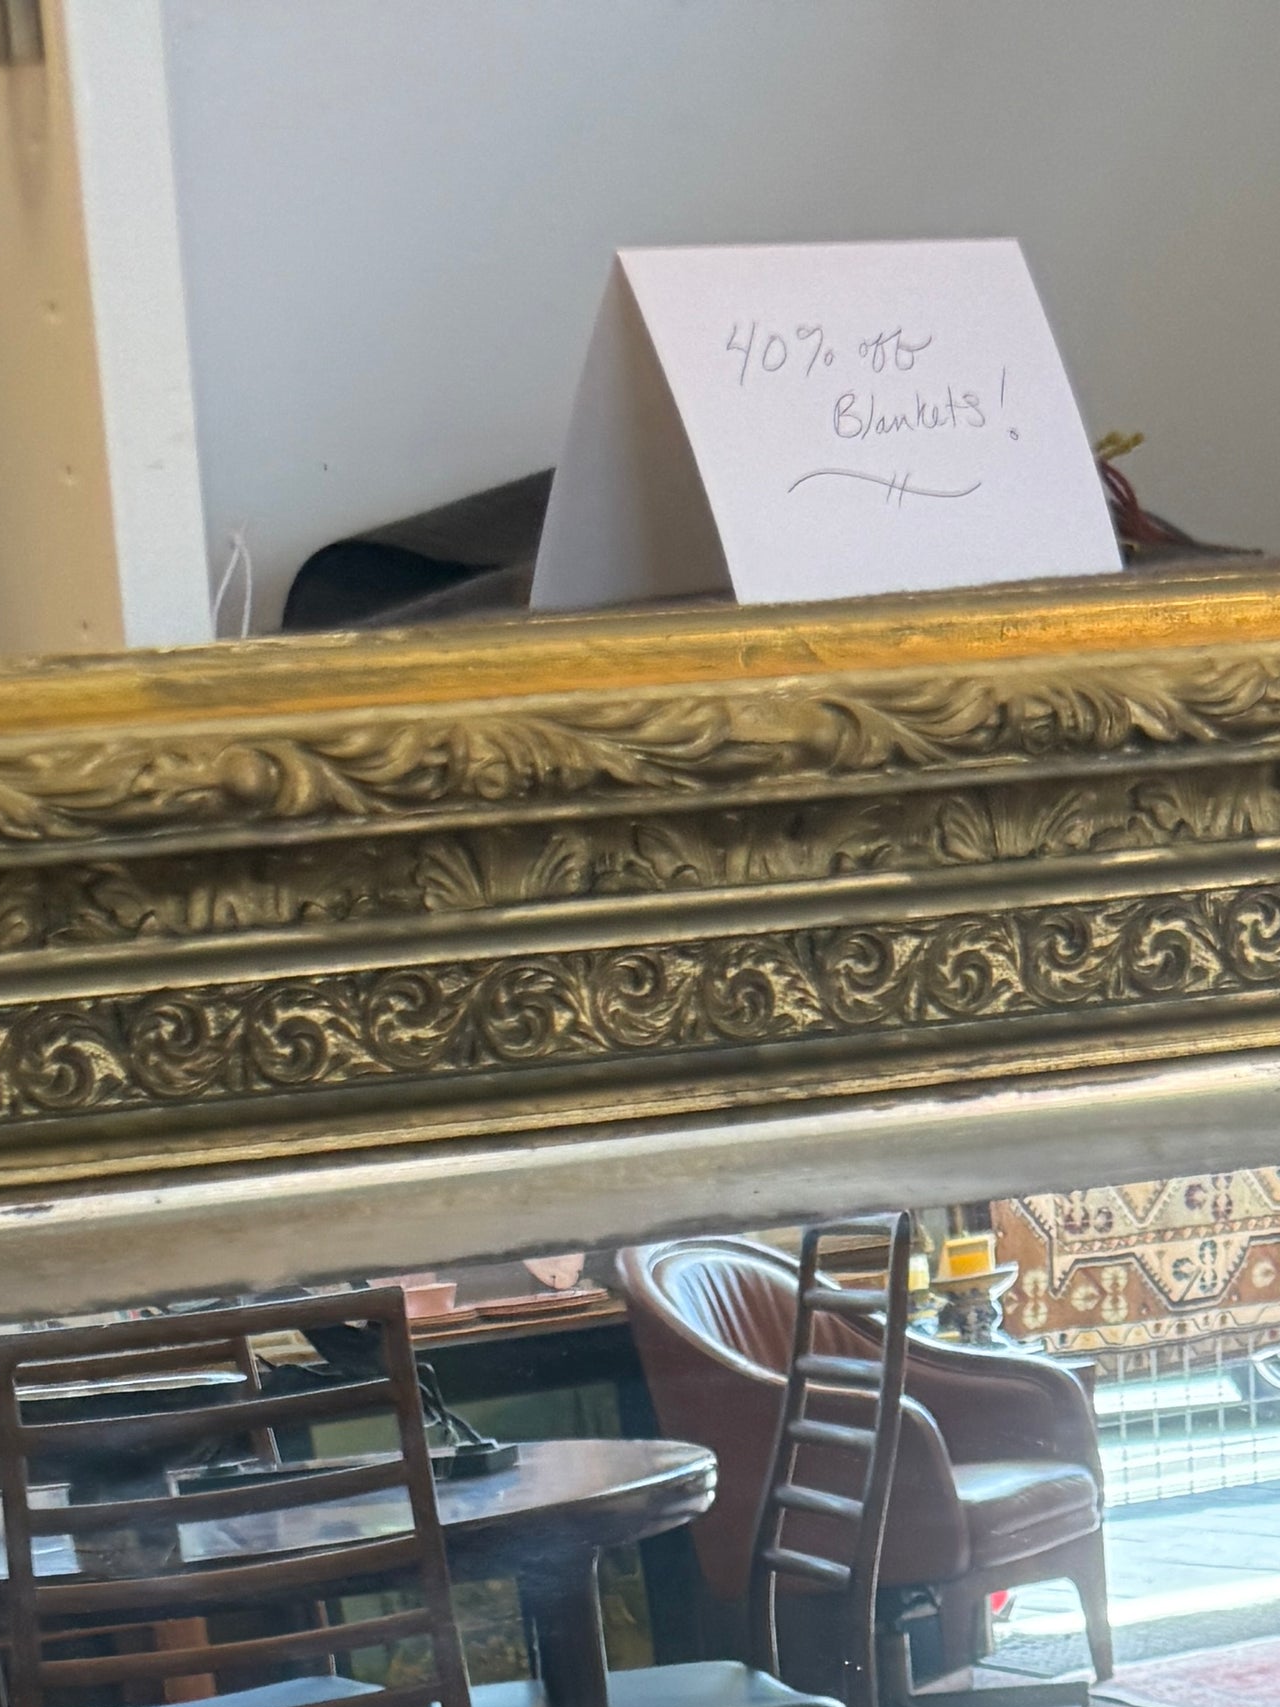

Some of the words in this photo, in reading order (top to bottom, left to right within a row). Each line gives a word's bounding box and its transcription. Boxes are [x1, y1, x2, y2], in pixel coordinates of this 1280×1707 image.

[726, 321, 834, 386] 40%
[858, 328, 933, 373] off
[833, 364, 1020, 440] Blankets!
